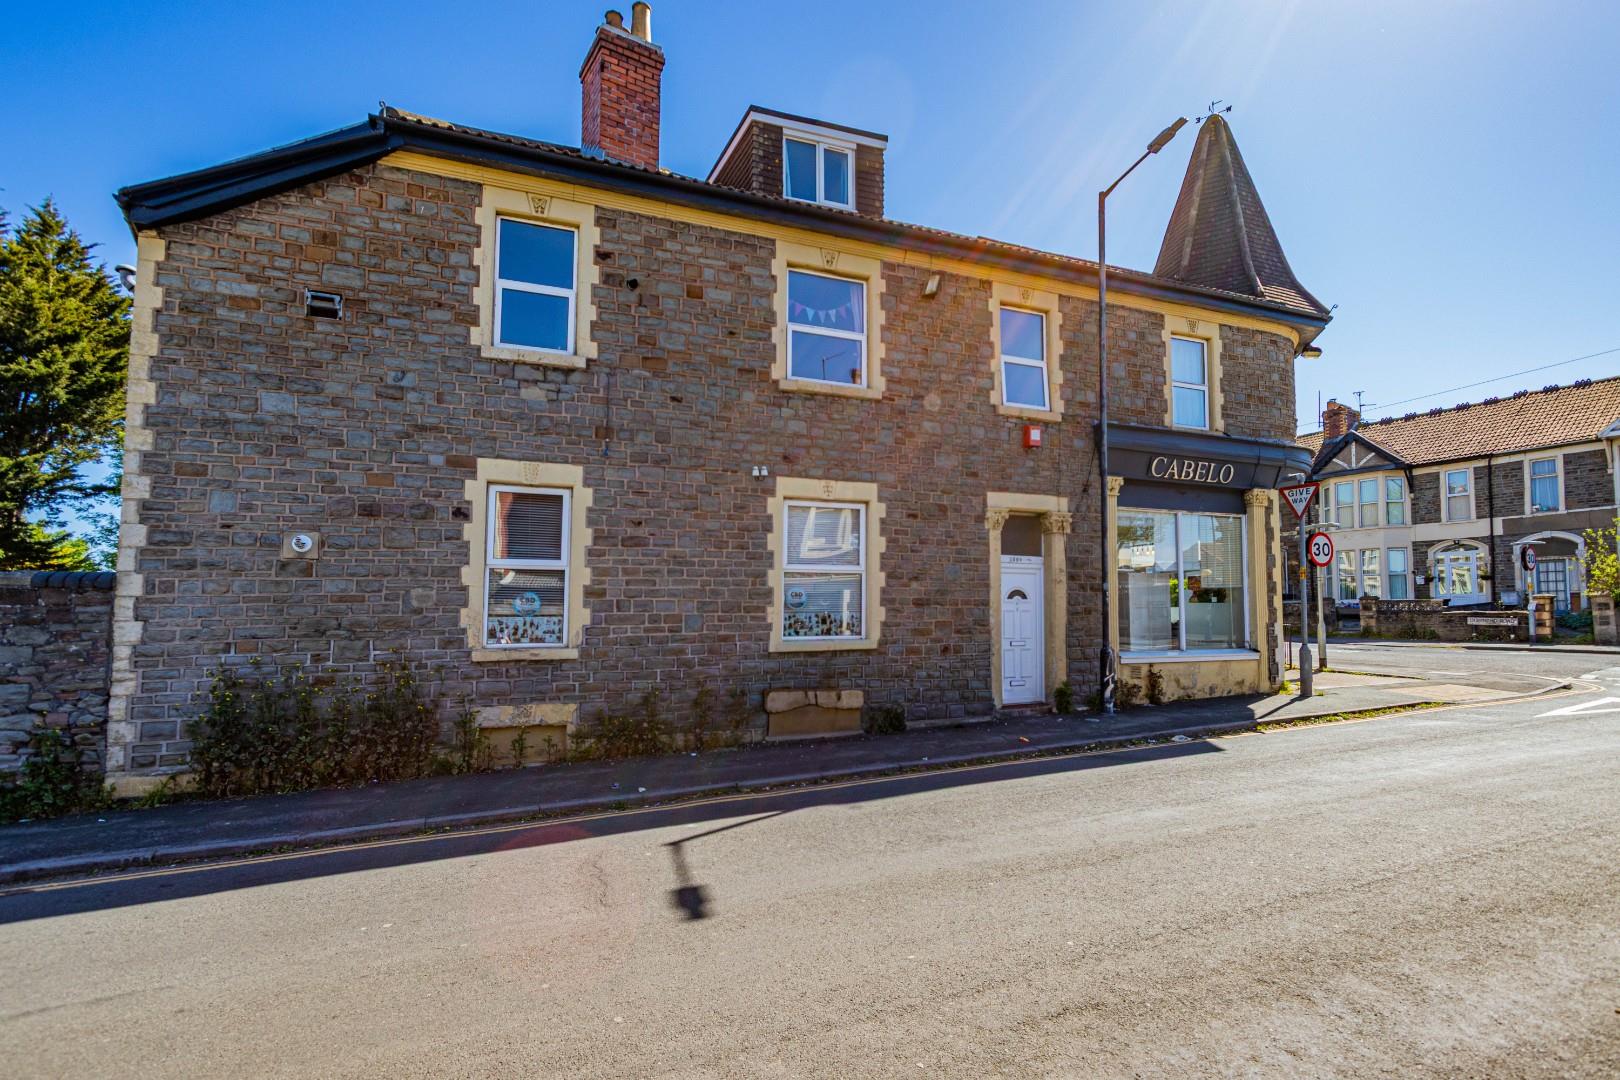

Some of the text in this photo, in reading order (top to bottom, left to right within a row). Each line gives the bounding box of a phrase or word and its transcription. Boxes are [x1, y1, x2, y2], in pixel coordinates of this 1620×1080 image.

[1151, 456, 1235, 484] CABELO
[1287, 487, 1311, 498] GIVE
[1291, 496, 1309, 504] WAY
[1313, 542, 1330, 557] 30
[1527, 553, 1535, 564] 30
